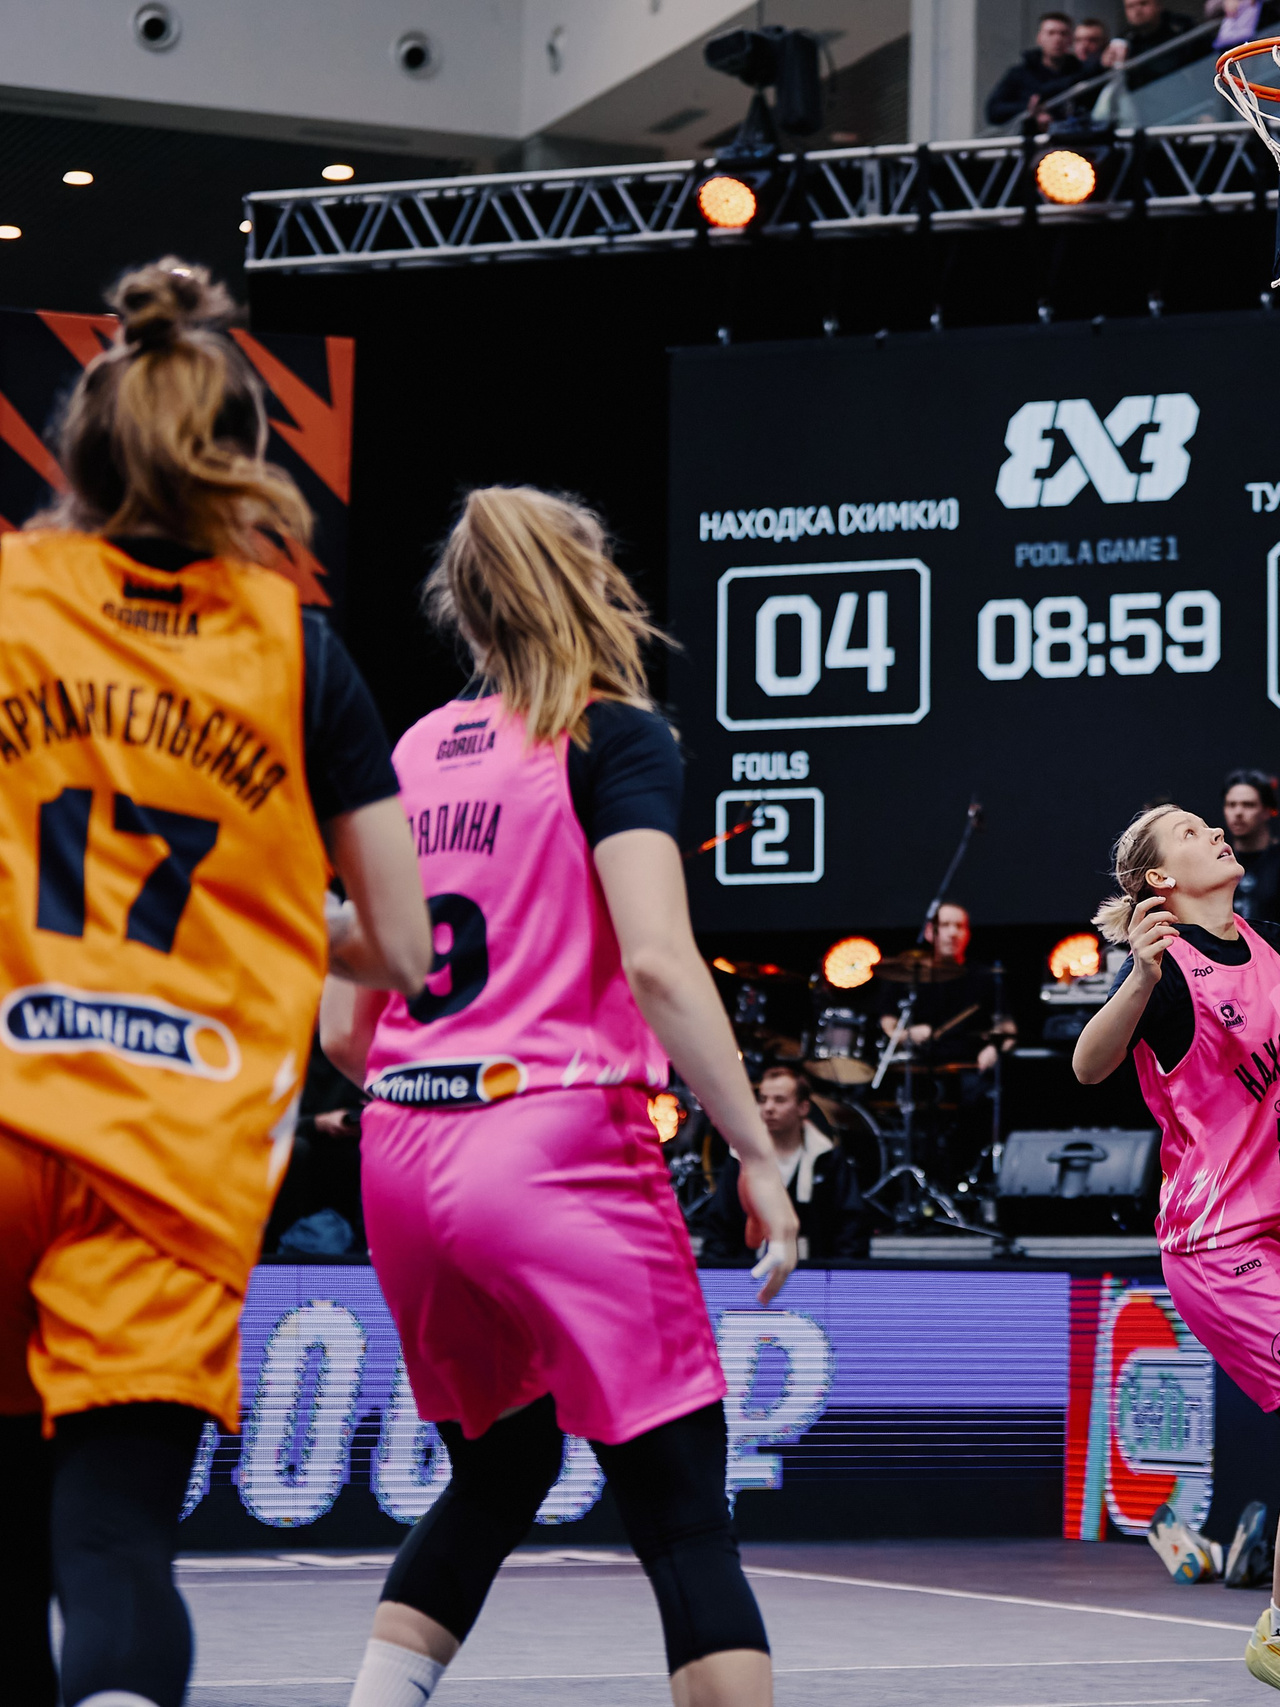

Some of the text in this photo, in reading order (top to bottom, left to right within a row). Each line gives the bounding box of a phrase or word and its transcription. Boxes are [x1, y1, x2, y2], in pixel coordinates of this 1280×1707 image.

[700, 505, 836, 543] НАХОДКА
[1014, 535, 1180, 568] POOL A GAME 1
[102, 601, 200, 637] GORILLA
[977, 589, 1222, 682] 08:59
[755, 590, 896, 697] 04
[436, 730, 496, 761] GORILLA
[731, 750, 810, 782] FOULS
[751, 804, 789, 866] 2
[36, 786, 219, 955] 17
[406, 893, 489, 1024] 9
[1233, 1258, 1262, 1277] ZEDO
